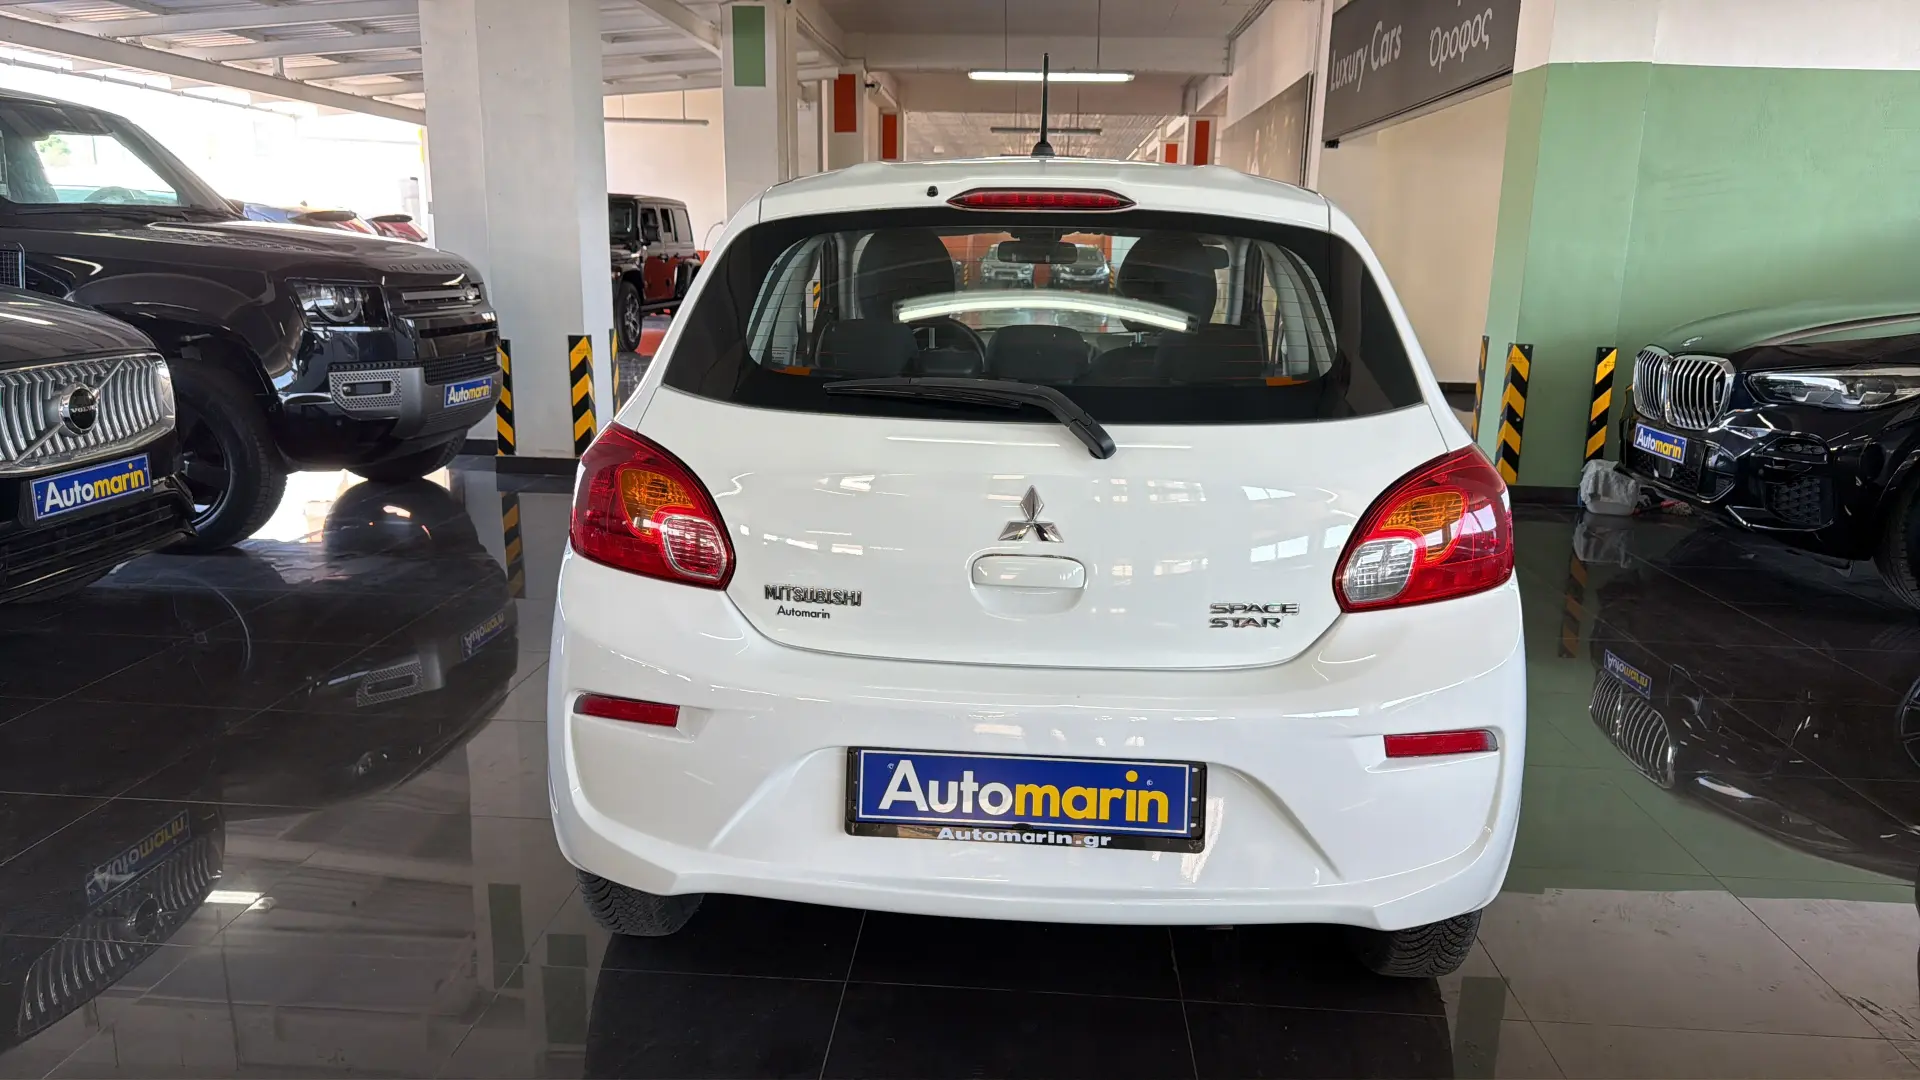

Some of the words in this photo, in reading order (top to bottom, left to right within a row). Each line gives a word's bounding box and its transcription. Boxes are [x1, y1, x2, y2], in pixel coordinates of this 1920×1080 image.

[1429, 7, 1493, 74] Όροφος
[1330, 44, 1369, 93] Luxury
[1371, 20, 1402, 72] Cars
[447, 379, 490, 405] Automarin
[1636, 427, 1682, 459] Automarin
[44, 462, 145, 513] Automarin
[763, 584, 862, 607] MITSUBISHI
[777, 605, 831, 619] Automarin
[1209, 603, 1300, 615] SPACE
[1208, 616, 1282, 629] STAR
[878, 758, 1169, 824] Automarin
[937, 826, 1113, 848] Automarin.gr
